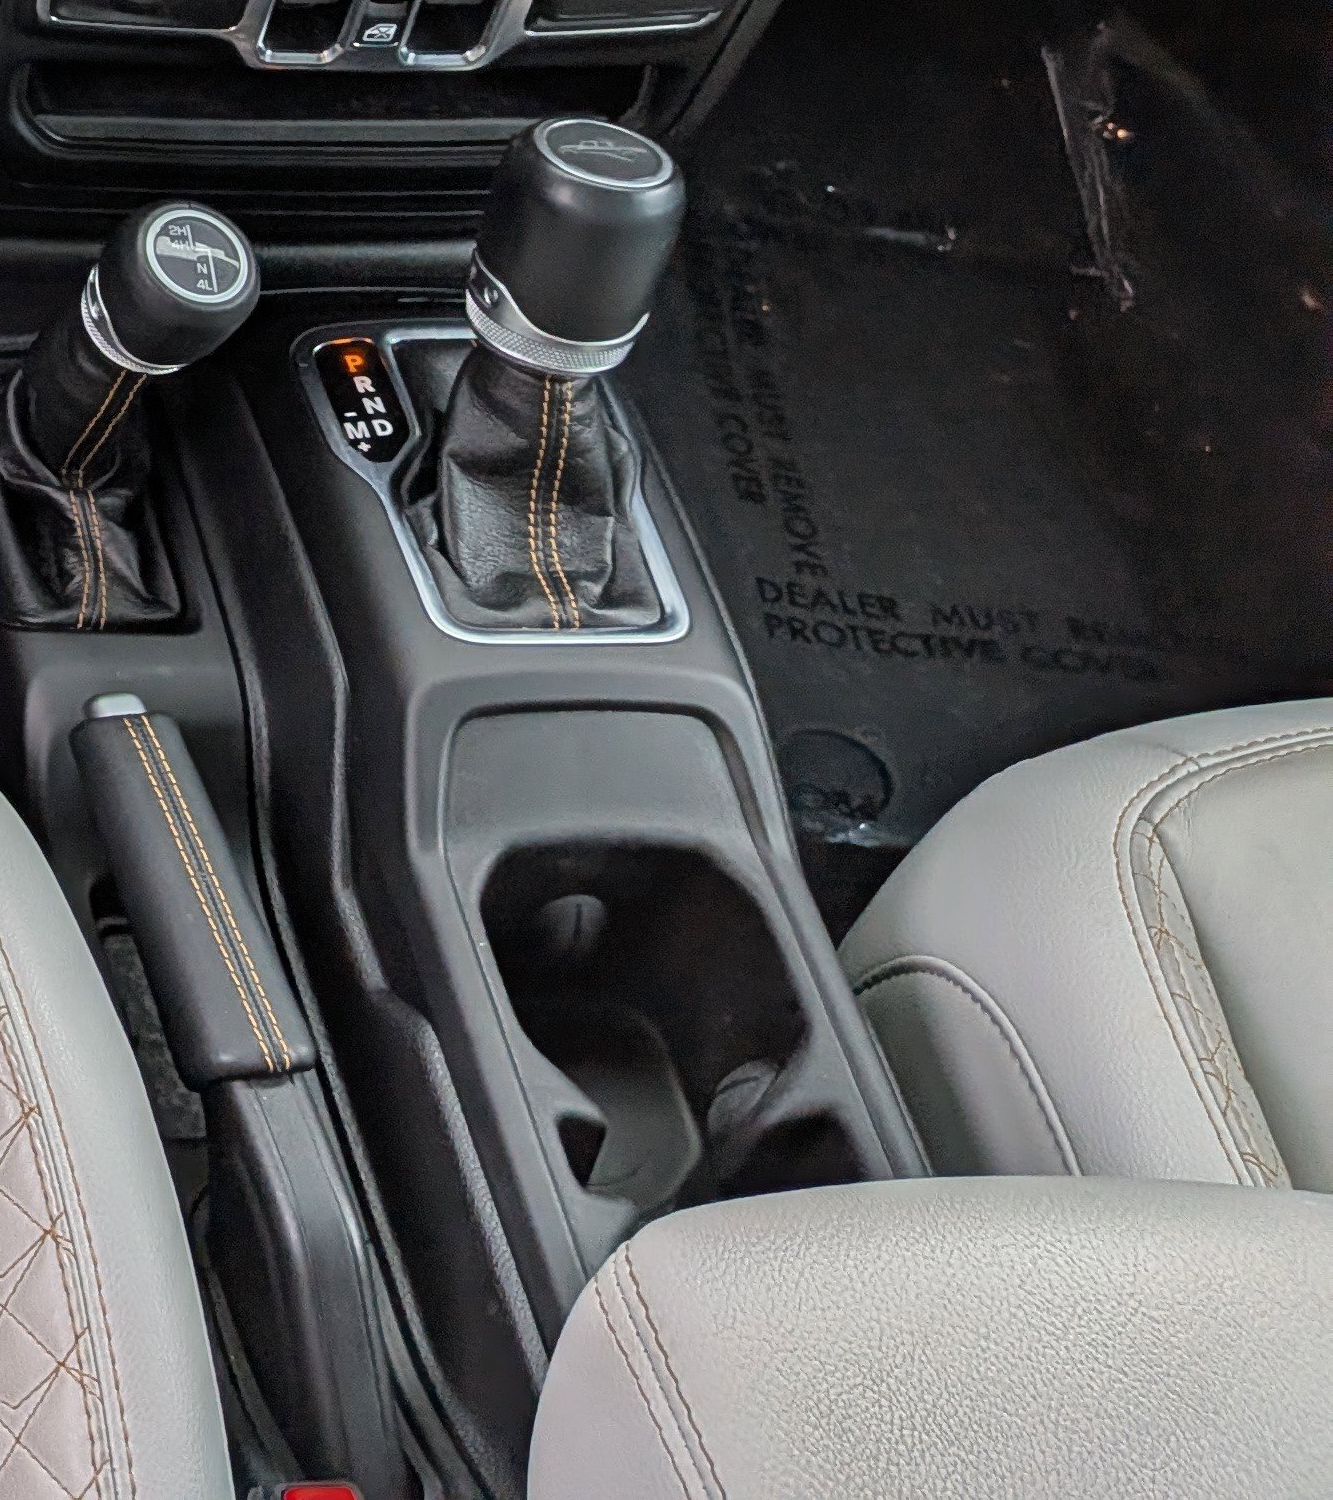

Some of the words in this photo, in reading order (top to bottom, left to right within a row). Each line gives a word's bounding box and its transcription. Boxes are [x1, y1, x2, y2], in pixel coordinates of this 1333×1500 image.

[168, 224, 187, 237] 2H
[171, 239, 190, 251] 4H
[196, 262, 208, 275] N
[196, 279, 213, 291] 4L
[344, 354, 363, 373] P
[353, 375, 376, 394] R
[361, 396, 387, 415] N
[343, 420, 371, 440] M
[371, 419, 394, 437] D
[756, 576, 903, 622] DEALER
[931, 601, 1040, 635] MUST
[763, 612, 1007, 663] PROTECTIVE
